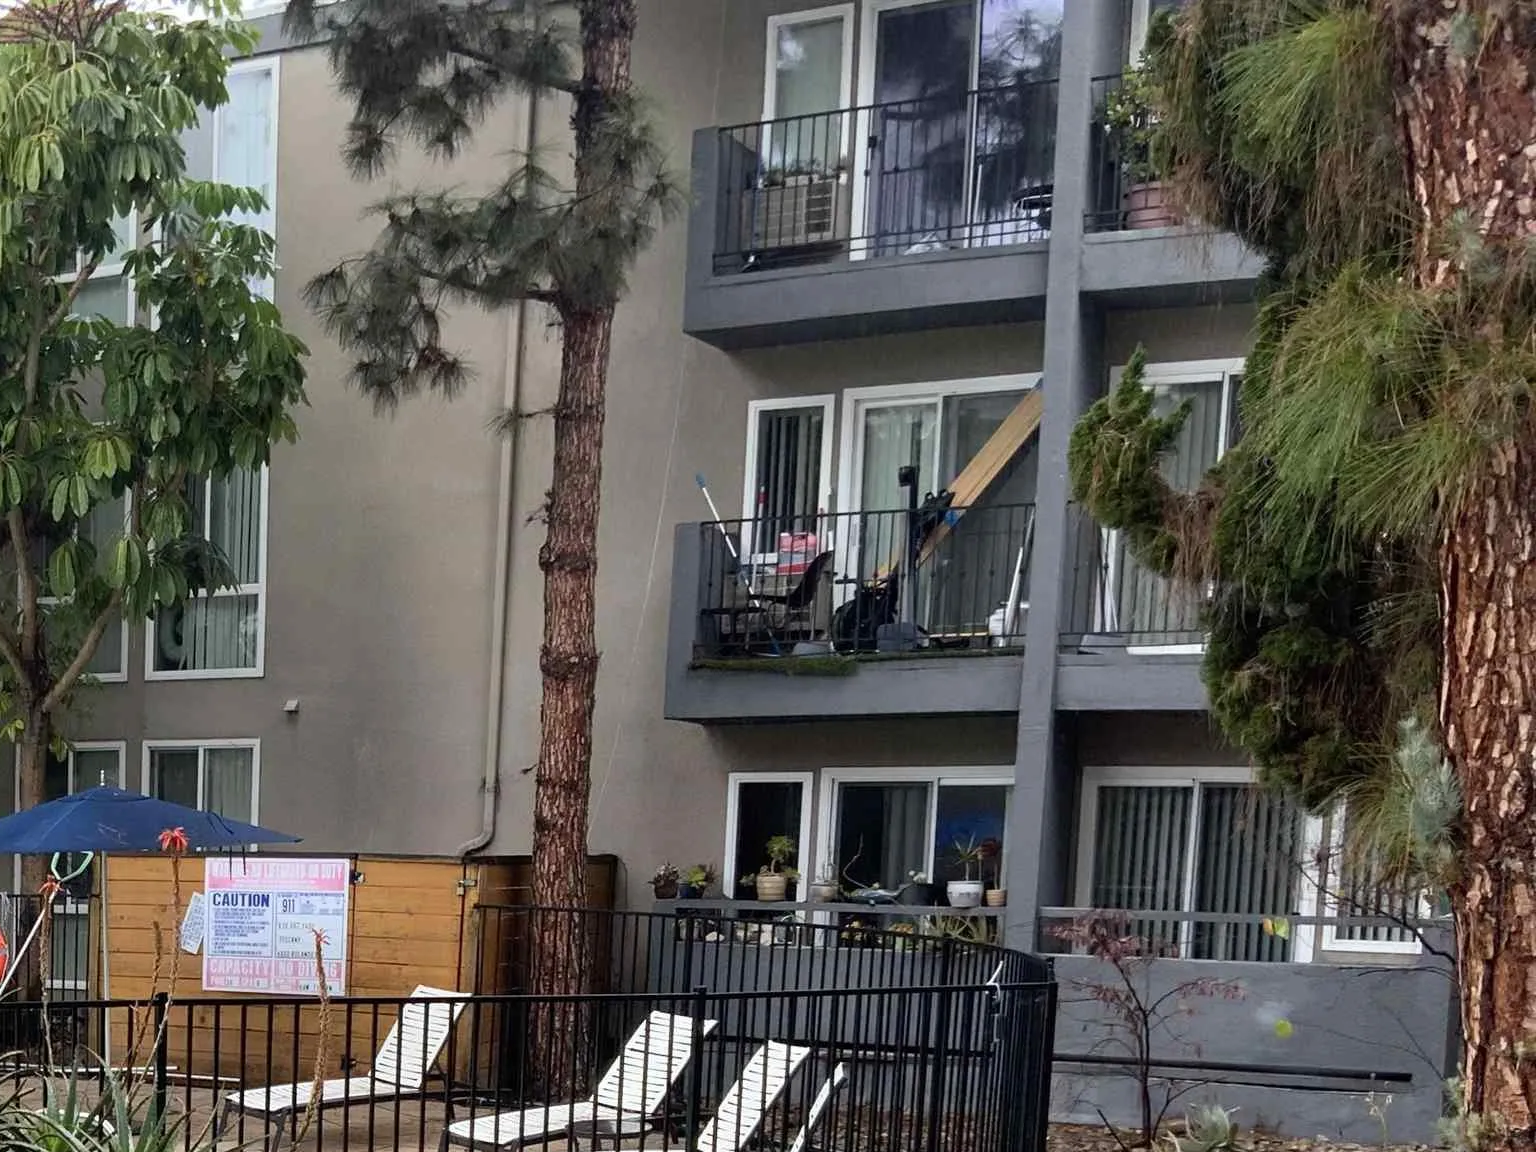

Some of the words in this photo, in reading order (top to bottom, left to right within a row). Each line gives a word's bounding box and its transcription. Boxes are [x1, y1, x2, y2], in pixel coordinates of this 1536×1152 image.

[213, 893, 270, 907] CAUTION
[282, 899, 295, 912] 911
[209, 959, 270, 977] CAPACITY
